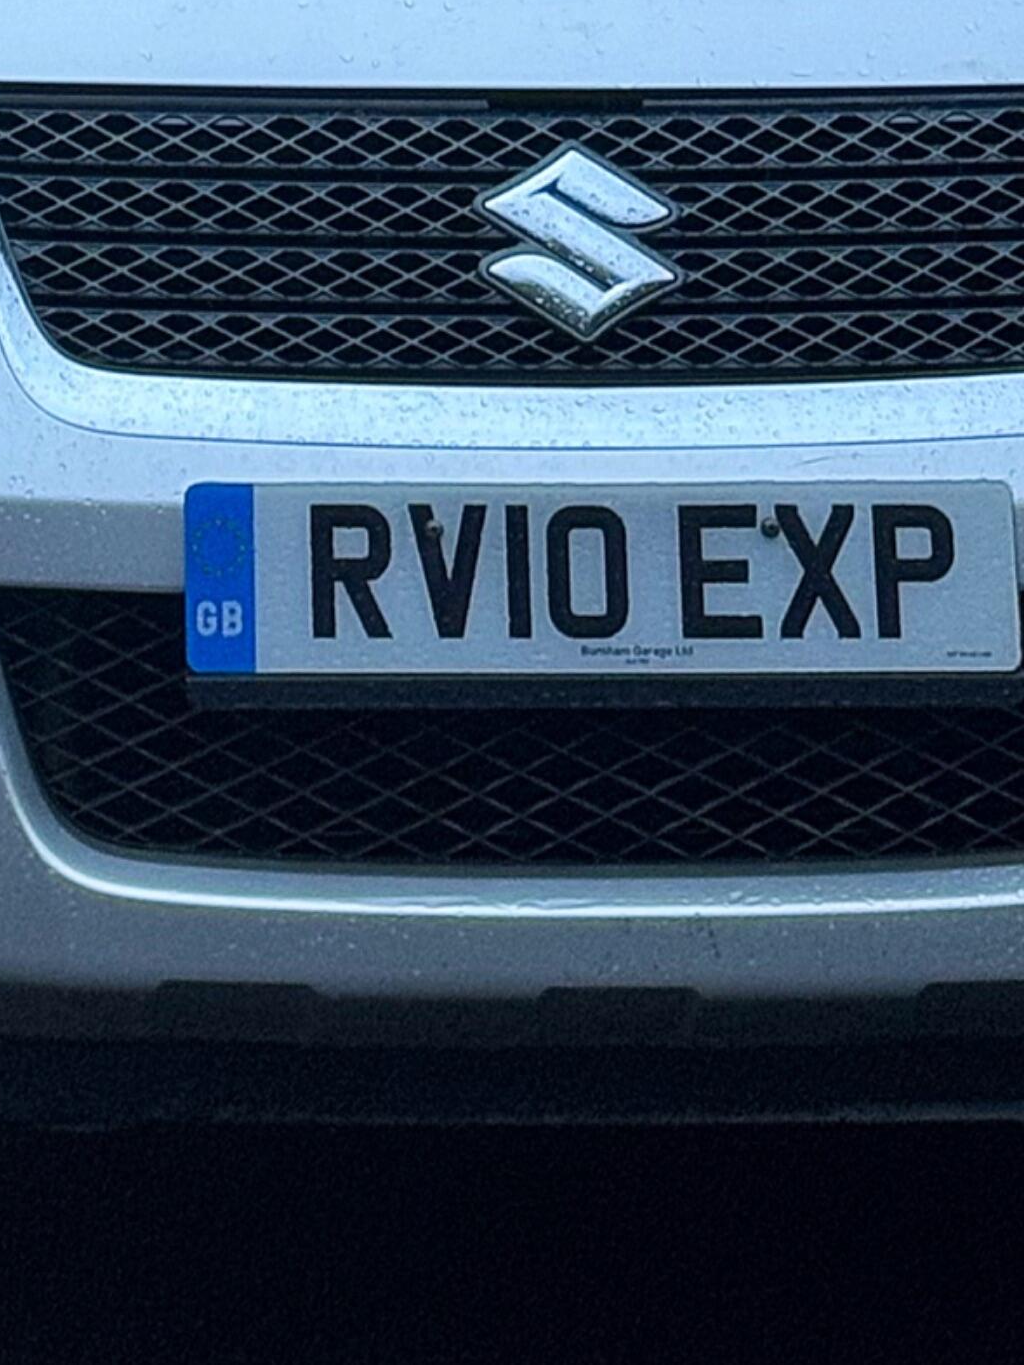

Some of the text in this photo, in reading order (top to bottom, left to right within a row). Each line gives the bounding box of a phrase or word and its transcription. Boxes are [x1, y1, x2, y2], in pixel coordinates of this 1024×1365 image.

[309, 503, 955, 639] RV10 EXP
[196, 601, 243, 637] GB
[633, 644, 673, 659] Garage
[675, 644, 694, 656] Ltd
